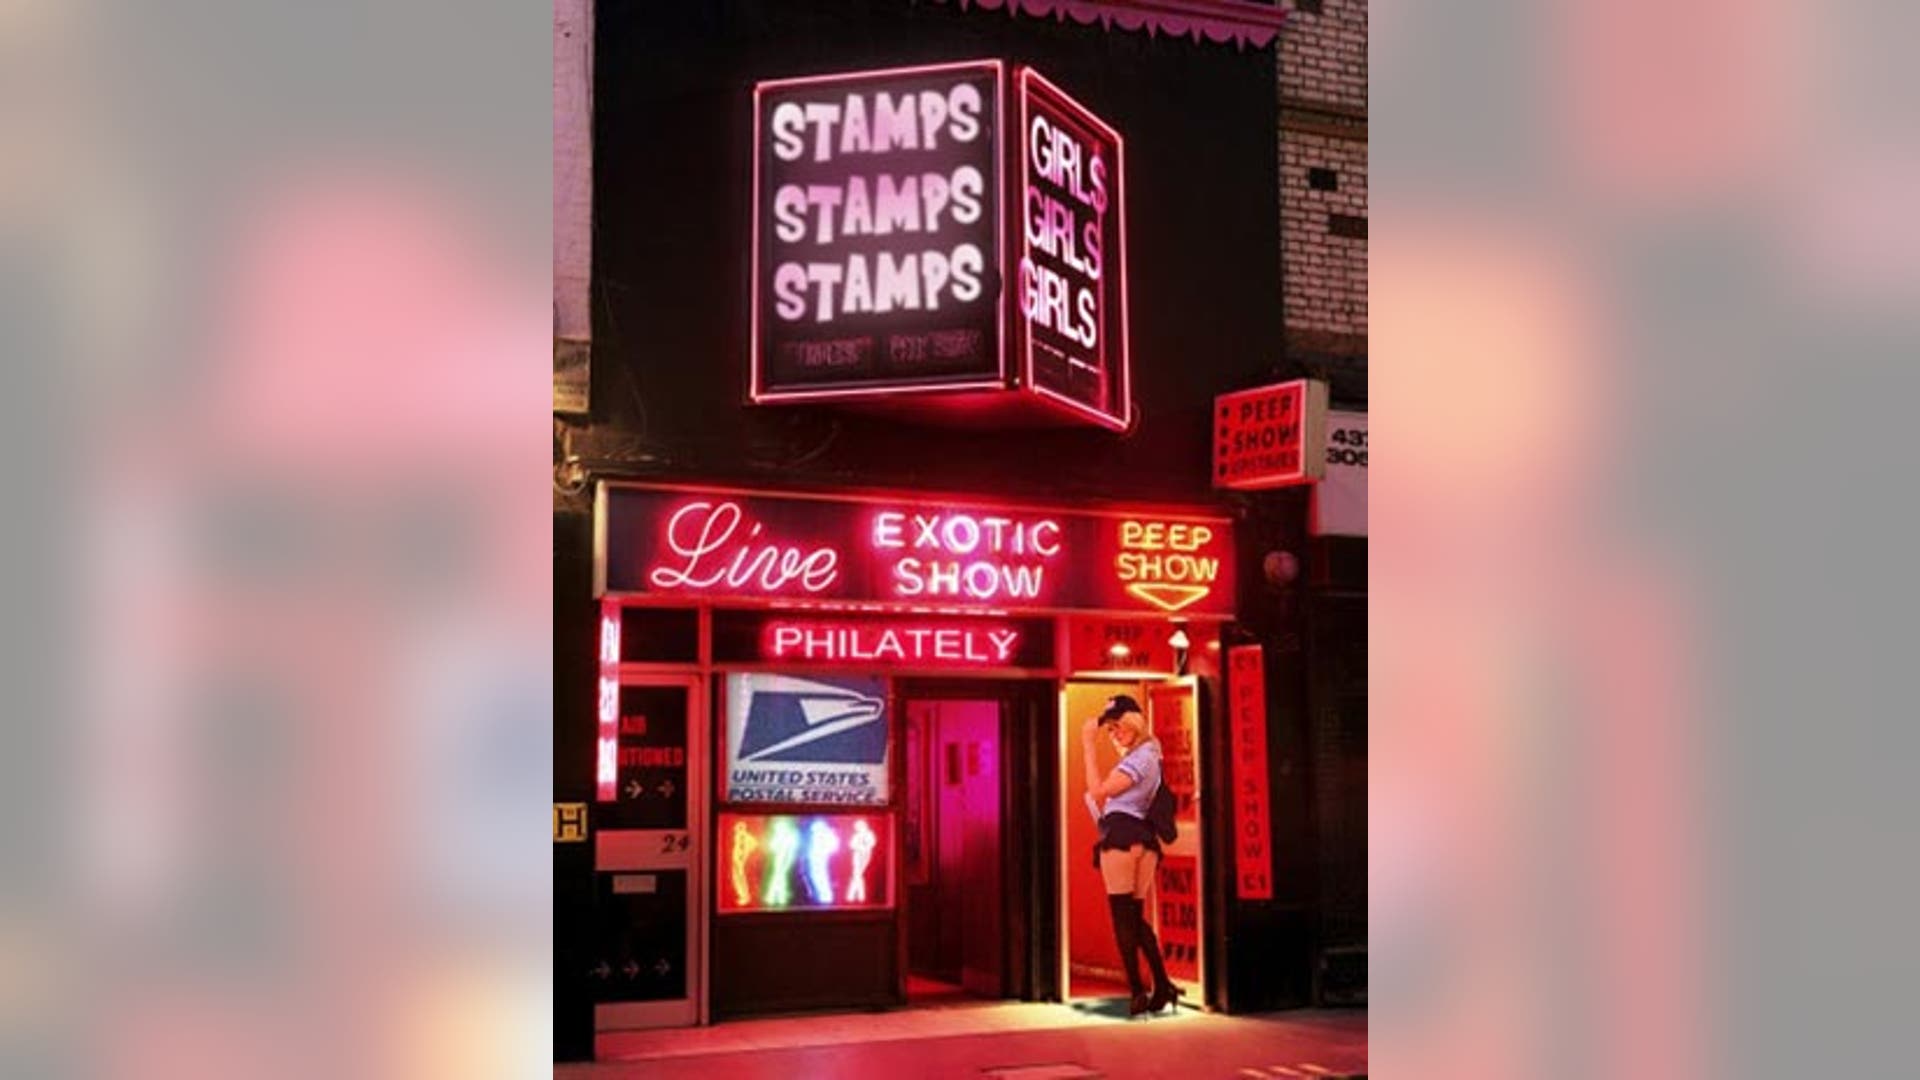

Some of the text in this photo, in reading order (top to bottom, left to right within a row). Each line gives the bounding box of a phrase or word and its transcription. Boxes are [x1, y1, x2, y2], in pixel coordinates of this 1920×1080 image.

[772, 83, 982, 162] STAMPS
[1030, 115, 1108, 211] GIRLS
[774, 166, 983, 245] STAMPS
[1027, 186, 1104, 280] GIRLS
[774, 243, 983, 322] STAMPS
[1020, 256, 1097, 348] GIRLS
[1241, 395, 1292, 421] PEEP
[1234, 424, 1299, 452] SHOW
[650, 502, 839, 591] Live
[874, 511, 1060, 556] EXOTIC
[1121, 521, 1212, 549] PEEP
[896, 560, 1045, 599] SHOW
[1117, 552, 1219, 582] SHOW
[773, 626, 1017, 662] PHILATELY
[729, 788, 795, 802] POSTAL
[732, 771, 870, 786] UNITED STATES
[557, 808, 583, 838] H
[1244, 780, 1262, 858] SHOW
